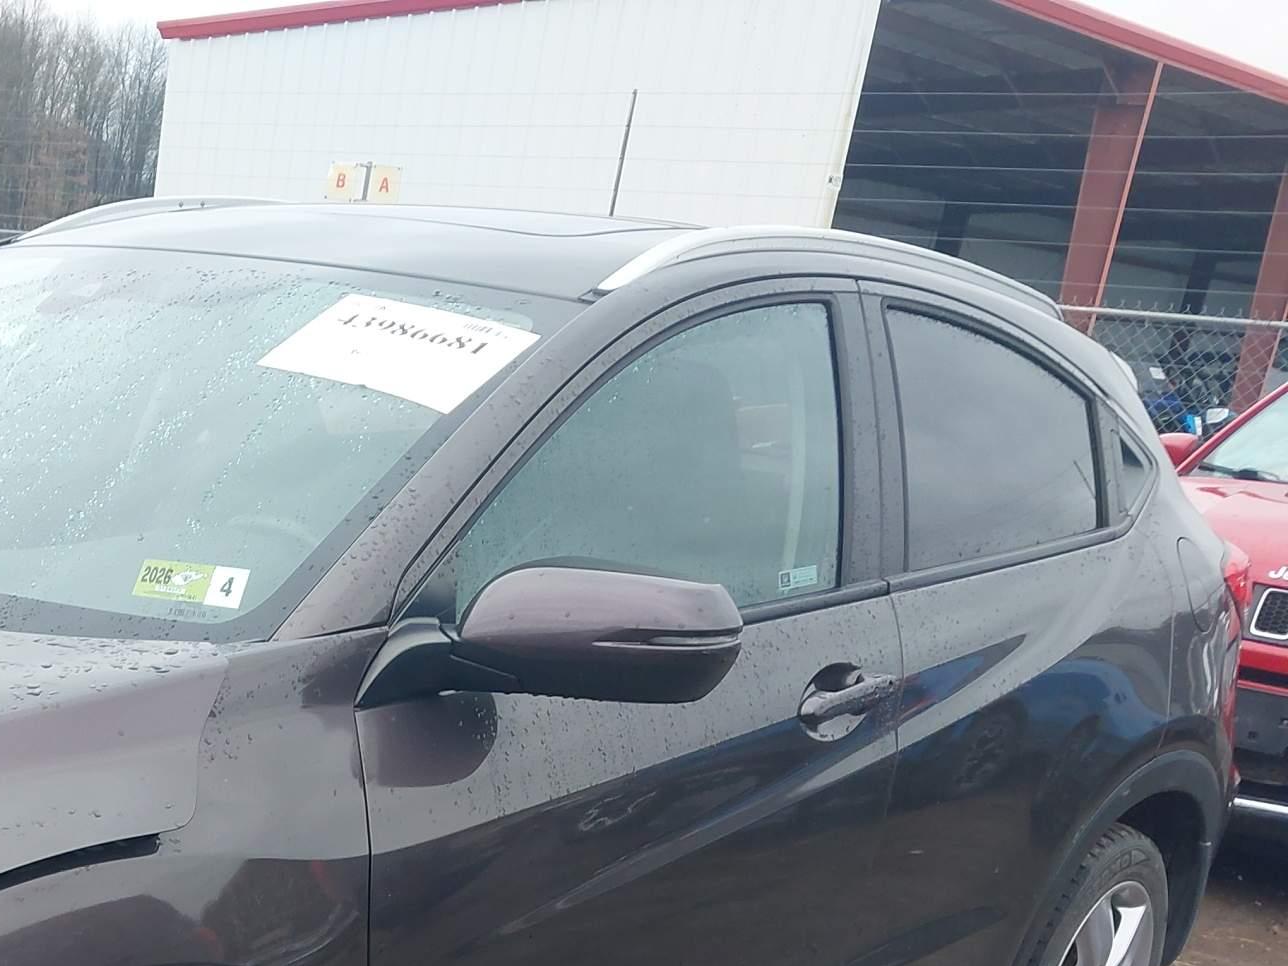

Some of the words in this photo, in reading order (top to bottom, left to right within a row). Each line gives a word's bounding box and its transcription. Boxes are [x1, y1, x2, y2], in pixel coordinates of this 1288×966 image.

[336, 173, 346, 188] B
[378, 177, 389, 193] A
[336, 313, 489, 355] 43986681
[140, 565, 173, 585] 2026
[220, 576, 234, 597] 4
